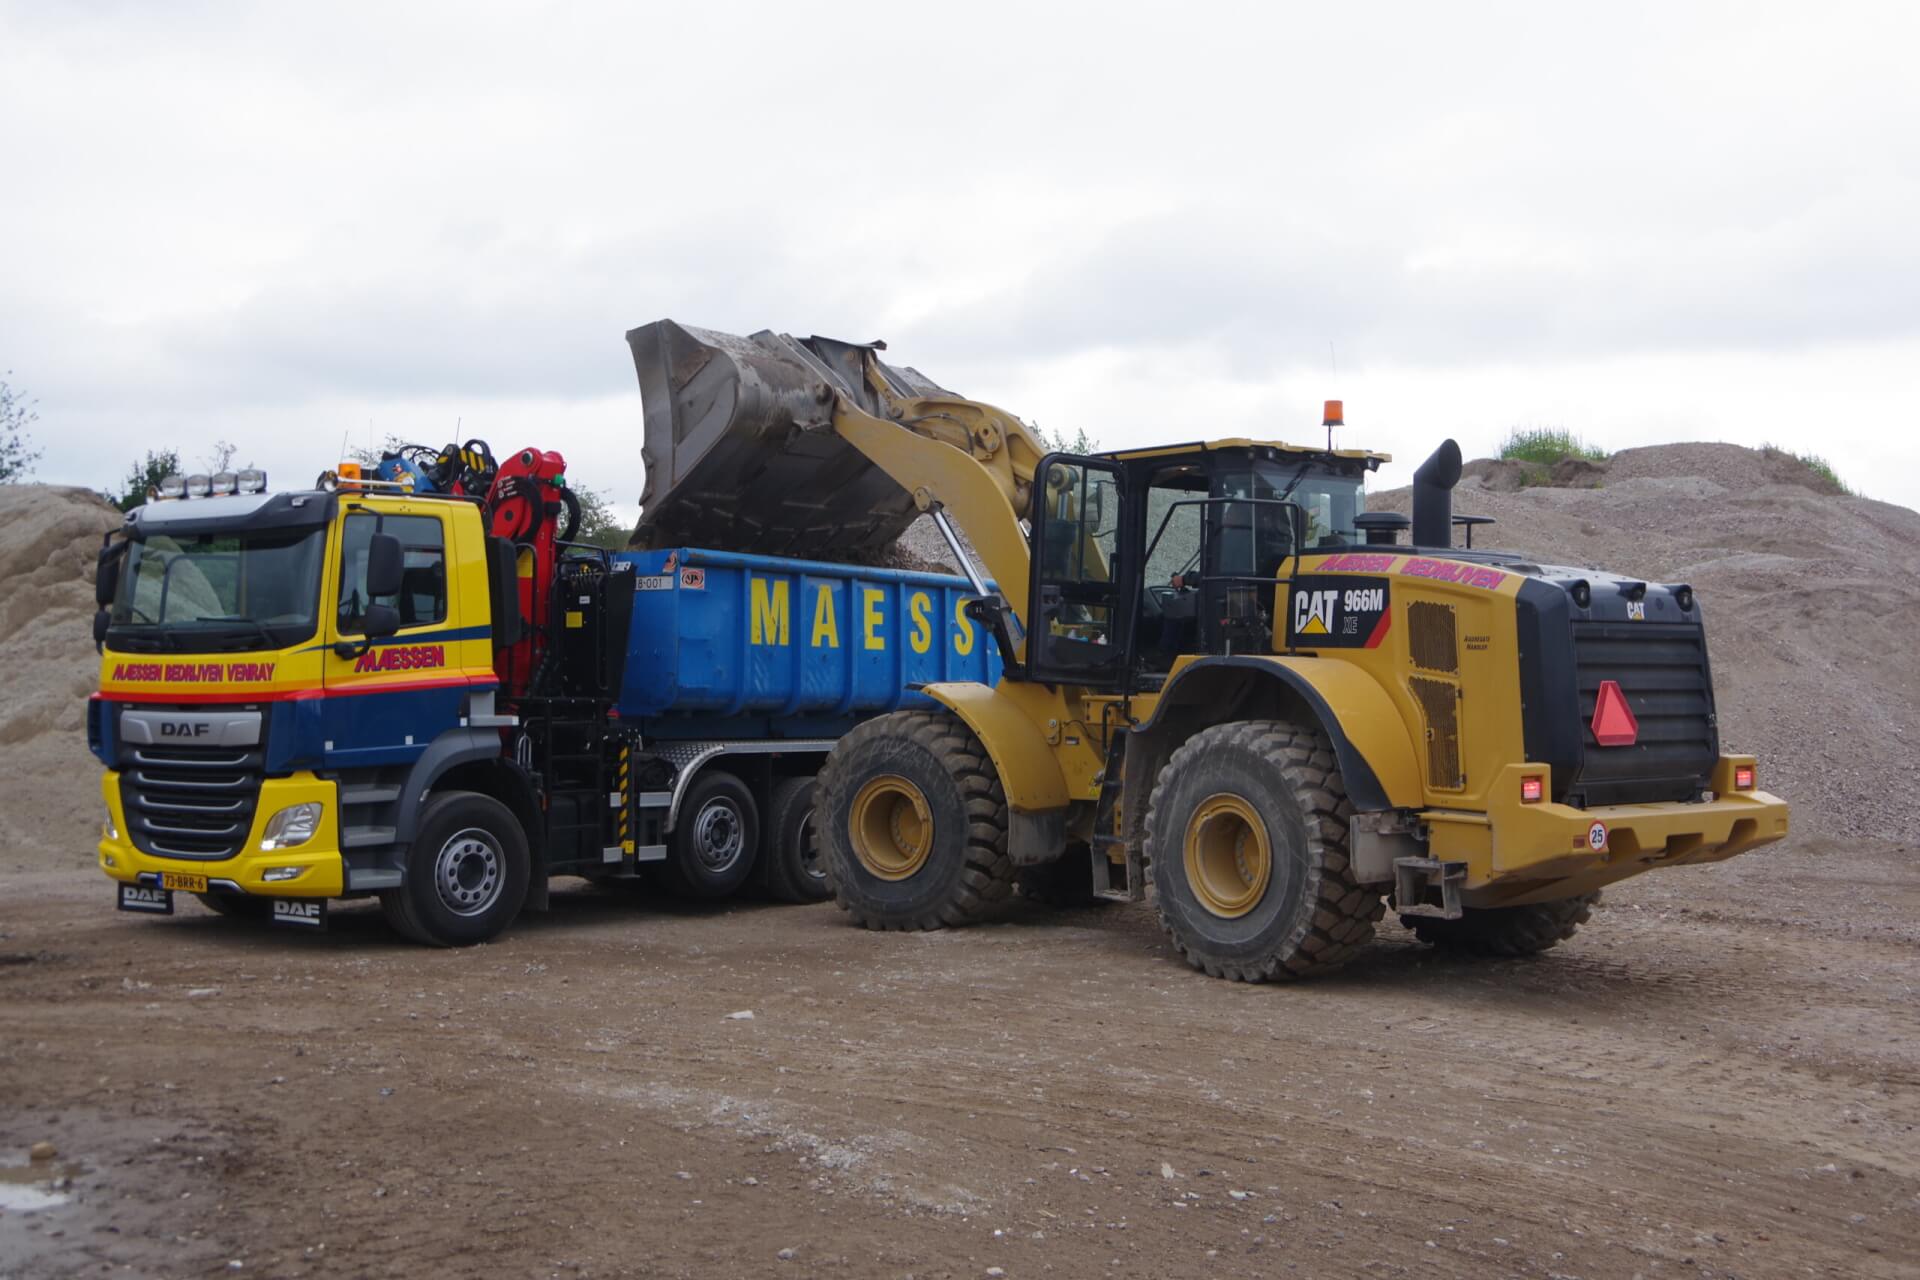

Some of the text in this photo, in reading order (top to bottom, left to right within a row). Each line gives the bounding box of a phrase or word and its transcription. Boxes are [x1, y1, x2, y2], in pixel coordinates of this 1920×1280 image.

[1344, 589, 1383, 612] 966M
[751, 577, 1000, 656] MAESS
[1295, 590, 1338, 634] CAT
[1627, 602, 1645, 619] CAT
[1342, 616, 1358, 634] XE
[354, 645, 444, 672] MAESSEN
[112, 663, 275, 682] MAESSEN BEDRIJVEN VENRAY
[161, 722, 209, 736] DAF
[1592, 829, 1603, 843] 25
[164, 874, 204, 890] 73-BRR-6
[124, 886, 167, 900] DAF
[274, 900, 320, 917] DAF
